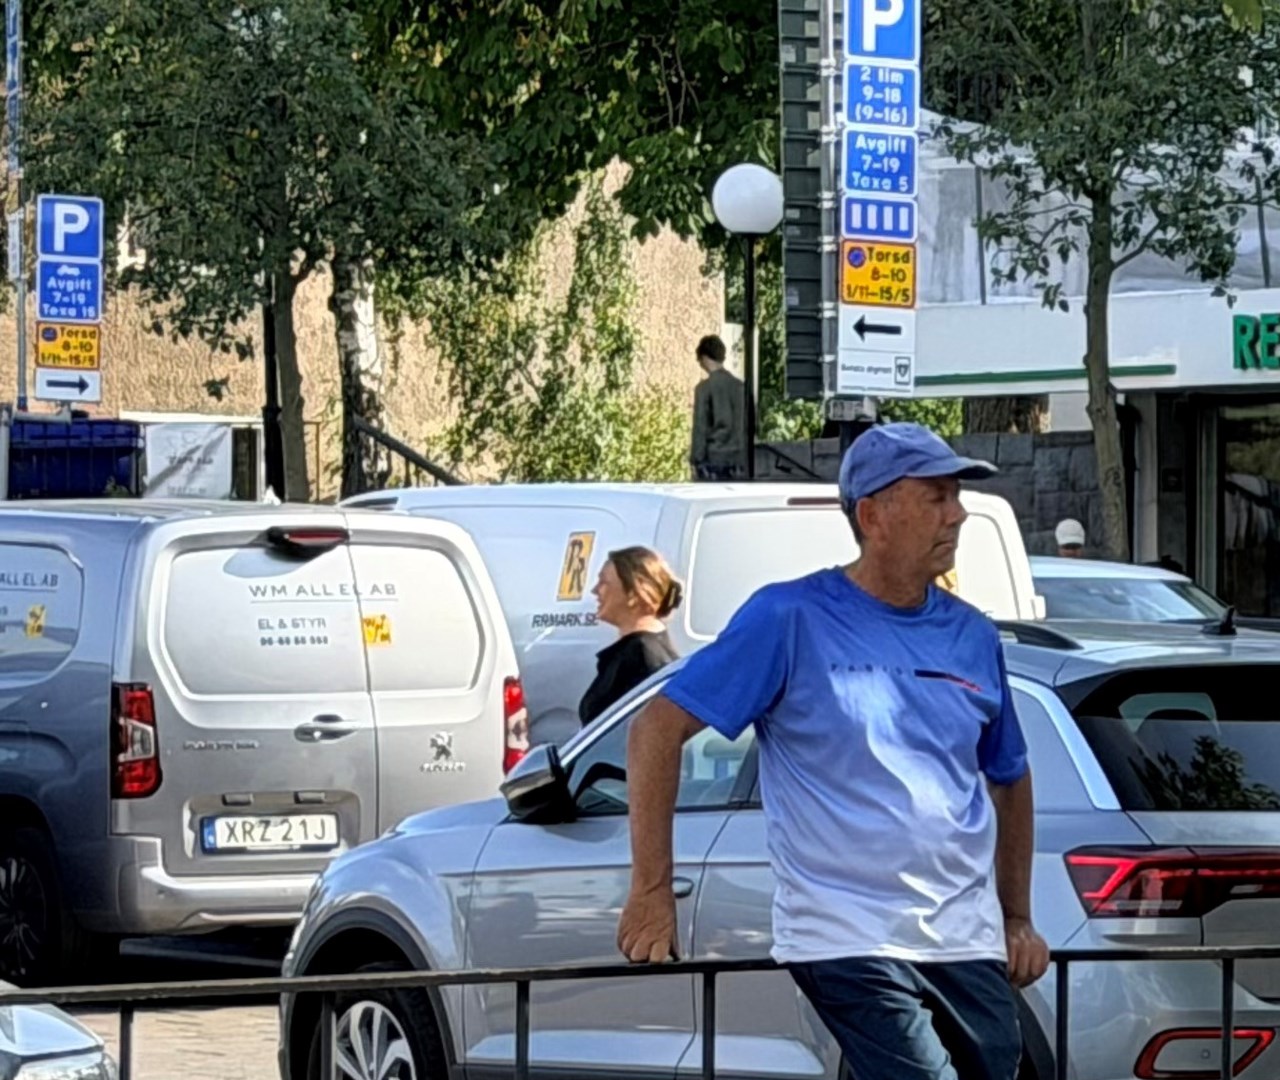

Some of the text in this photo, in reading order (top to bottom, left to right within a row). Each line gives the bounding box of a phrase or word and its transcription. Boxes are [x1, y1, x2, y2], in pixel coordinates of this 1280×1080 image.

[863, 0, 904, 52] P
[860, 67, 872, 82] 2
[862, 85, 901, 103] 9-18
[855, 103, 907, 124] (9-16)
[855, 134, 907, 155] Avgift
[862, 155, 901, 173] 7-19
[852, 172, 909, 192] Taxa 5
[54, 203, 90, 251] P
[868, 247, 911, 264] Torsd
[871, 267, 907, 283] 8-10
[47, 277, 92, 294] Avgift
[249, 584, 288, 597] WM
[296, 584, 335, 596] ALL
[370, 583, 397, 596] AB
[225, 818, 327, 843] XRZ 21J
